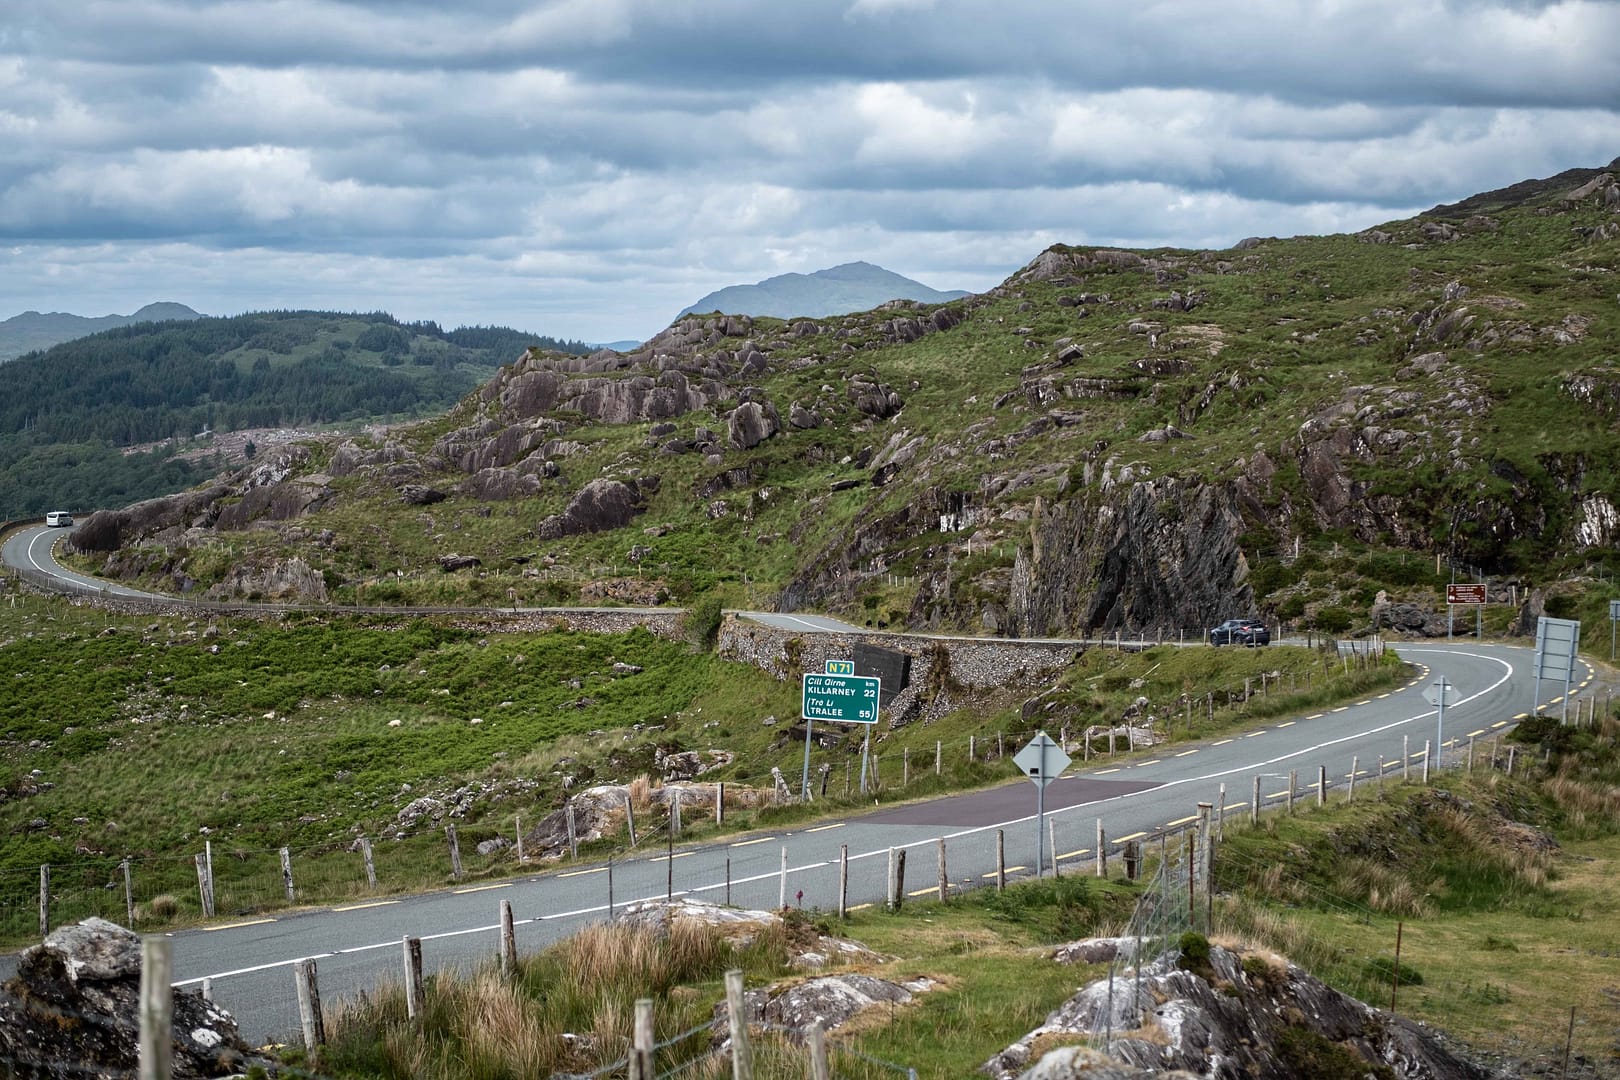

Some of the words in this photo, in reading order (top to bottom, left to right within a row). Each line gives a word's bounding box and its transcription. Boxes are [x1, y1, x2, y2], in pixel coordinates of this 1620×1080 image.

[808, 678, 822, 686] Cill
[808, 687, 856, 696] KILLARNEY
[864, 690, 876, 698] 22
[810, 708, 842, 716] TRALEE
[859, 710, 870, 718] 55
